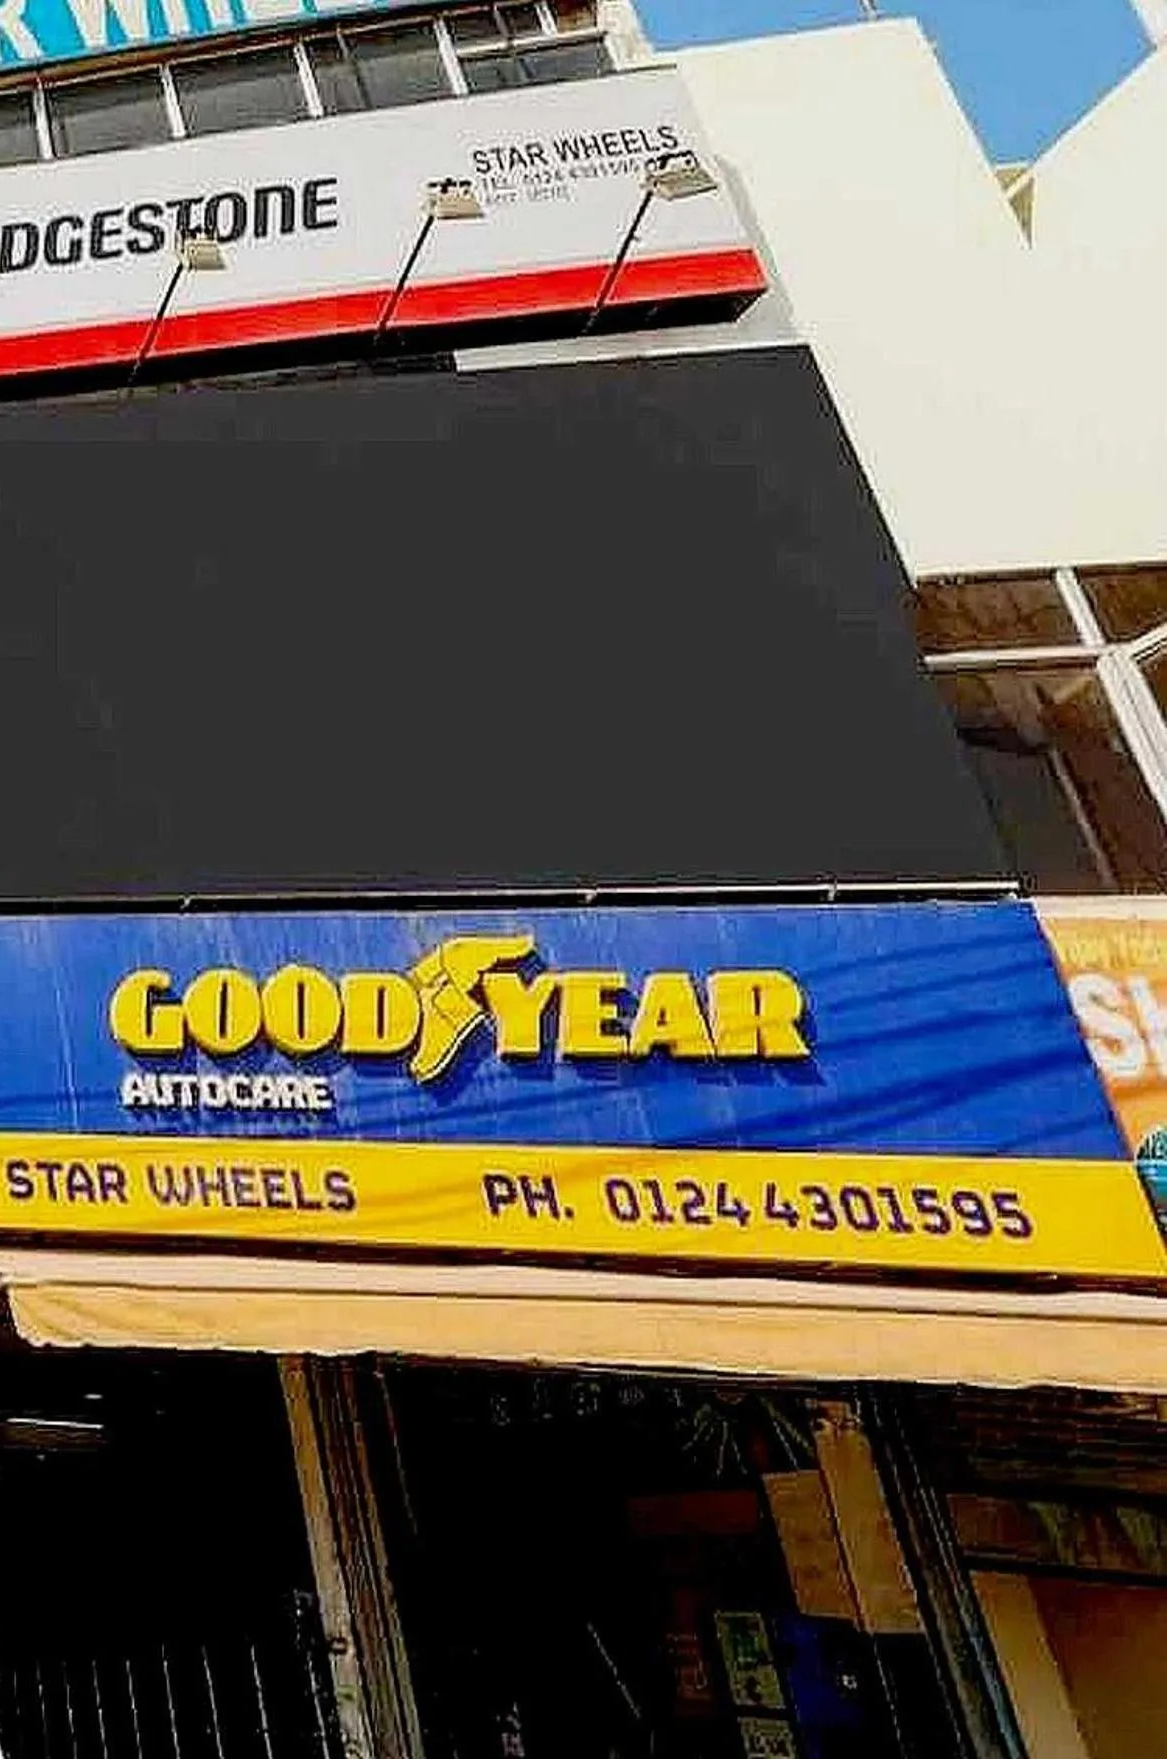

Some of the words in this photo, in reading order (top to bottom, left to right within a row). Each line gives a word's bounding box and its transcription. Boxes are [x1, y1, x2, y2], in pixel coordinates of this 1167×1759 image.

[473, 142, 548, 174] STAR
[554, 126, 679, 161] WHEELS
[111, 955, 812, 1066] GOODYEAR
[121, 1073, 335, 1112] AUTOCARE
[5, 1159, 128, 1203] STAR
[146, 1161, 357, 1213] WHEELS
[481, 1173, 574, 1220] PH.
